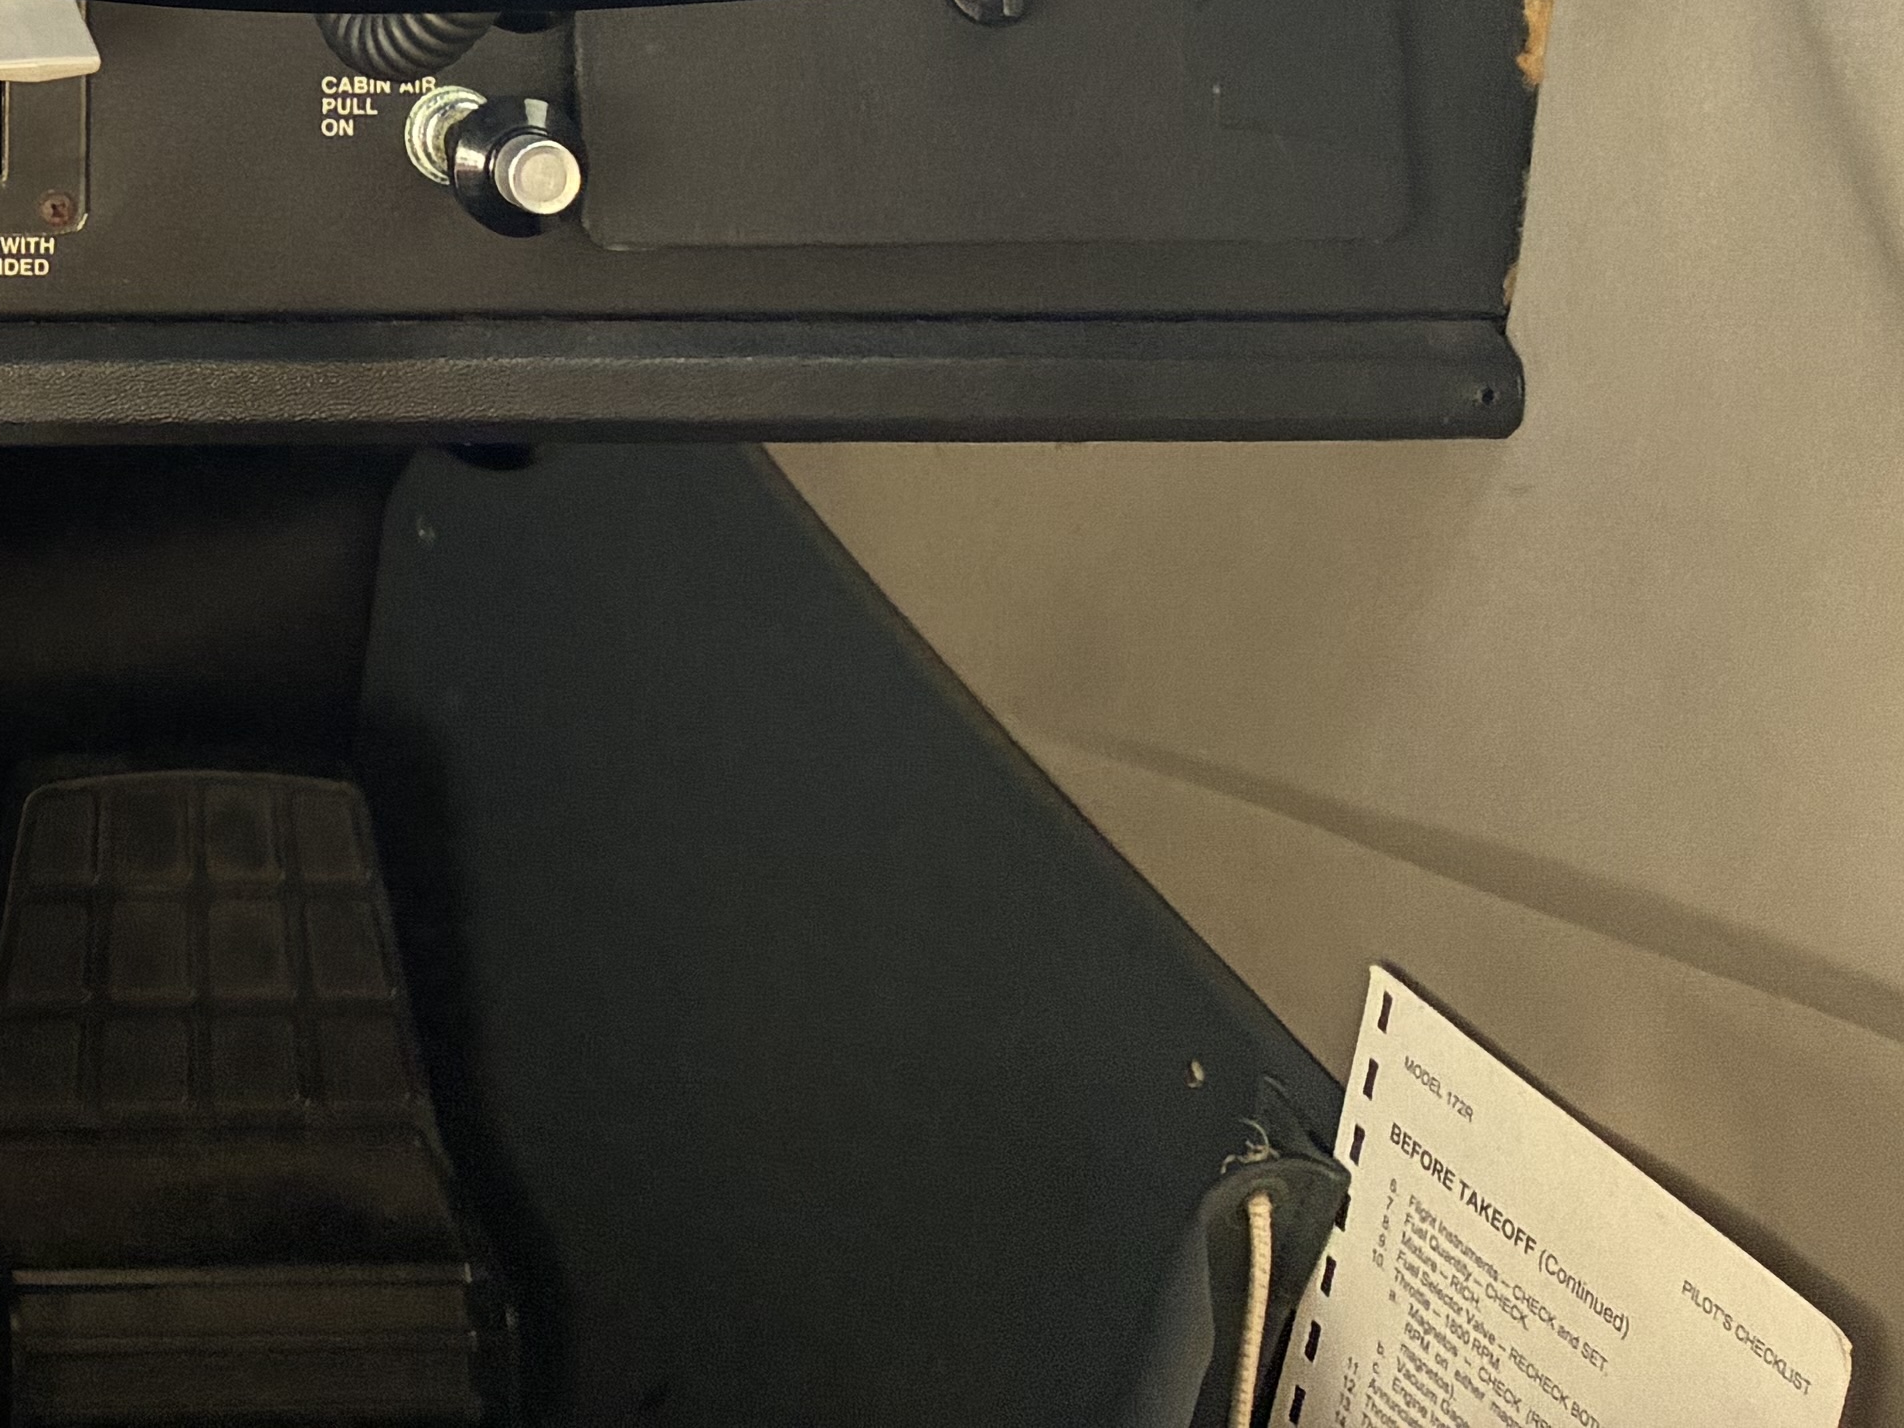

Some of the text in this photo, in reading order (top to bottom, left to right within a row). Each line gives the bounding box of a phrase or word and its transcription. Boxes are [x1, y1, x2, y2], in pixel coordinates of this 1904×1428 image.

[0, 235, 56, 255] WITH
[1390, 1122, 1631, 1340] BEFORE TAKEOFF (Continued)
[1682, 1279, 1812, 1395] PILOT'S CHECKLIST
